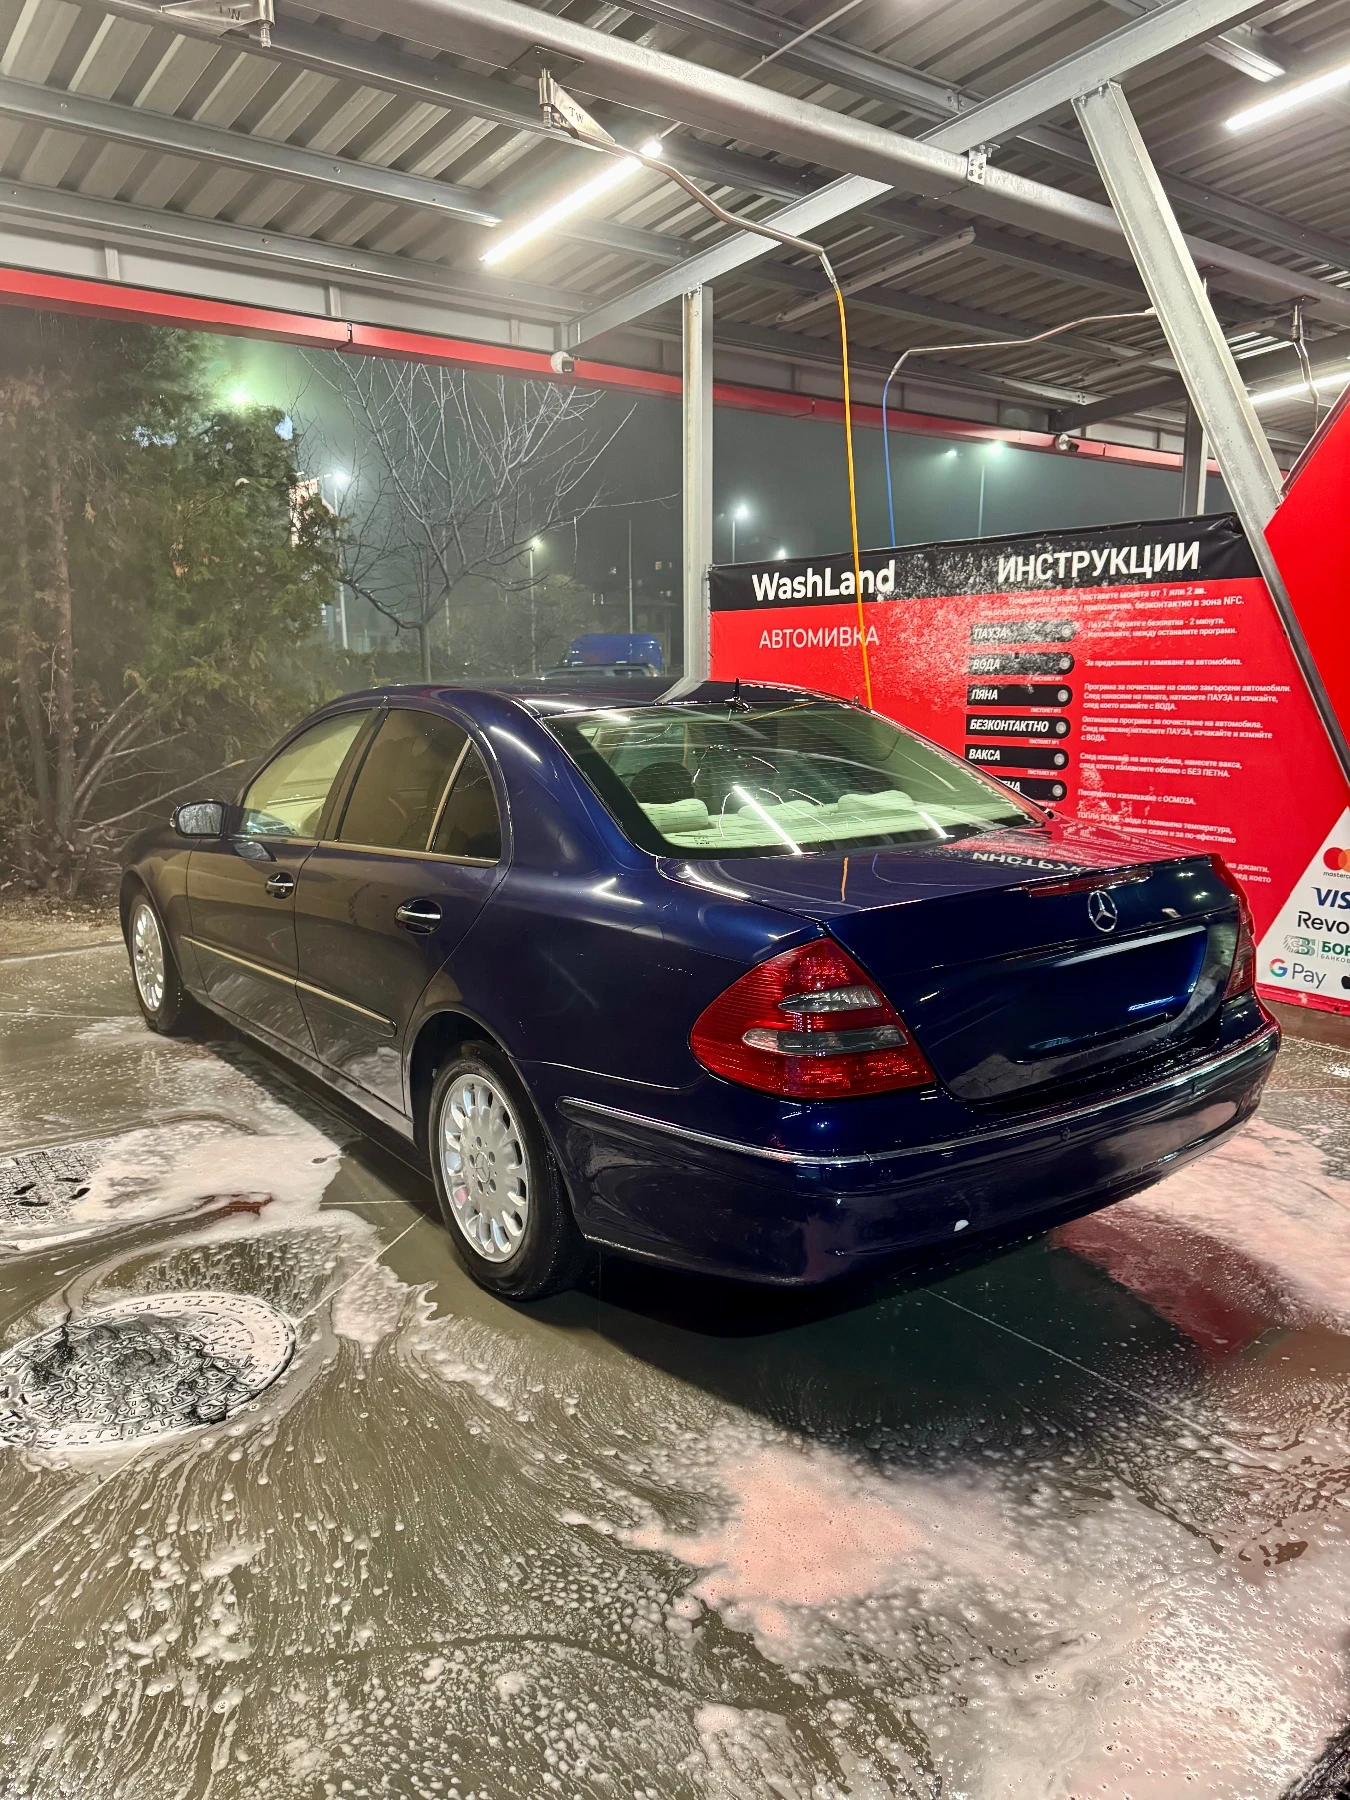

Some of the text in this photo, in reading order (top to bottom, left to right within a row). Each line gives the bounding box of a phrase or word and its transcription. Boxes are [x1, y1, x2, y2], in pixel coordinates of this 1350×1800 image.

[997, 540, 1200, 583] ИНСТРУКЦИИ
[751, 559, 895, 601] WashLand
[1120, 590, 1149, 600] монета
[1151, 589, 1160, 597] от
[1163, 587, 1167, 596] 1
[1169, 588, 1185, 596] или
[1187, 586, 1193, 595] 2
[1135, 599, 1191, 610] безконтактно
[1201, 598, 1221, 606] зона
[1223, 595, 1244, 605] NFC.
[1147, 618, 1184, 627] безплатна
[1190, 617, 1195, 625] 2
[1196, 616, 1225, 626] минути.
[758, 625, 880, 649] АВТОМИВКА
[973, 626, 1007, 640] ПАУЗА
[1133, 629, 1157, 638] между
[1157, 628, 1198, 637] останалите
[1199, 627, 1238, 637] програми.
[972, 658, 1001, 671] ВОДА
[1195, 657, 1243, 666] автомобила.
[971, 688, 999, 700] ПЯНА
[1084, 683, 1117, 691] Програма
[1199, 684, 1241, 692] замърсени
[1242, 683, 1292, 692] автомобили.
[1083, 692, 1101, 701] След
[1207, 694, 1233, 703] ПАУЗА
[1155, 703, 1178, 711] ВОДА.
[969, 719, 1050, 733] БЕЗКОНТАКТНО
[1082, 715, 1119, 724] Оптимална
[1119, 717, 1152, 726] програма
[1162, 719, 1204, 727] почистване
[1214, 720, 1263, 729] автомобила.
[1081, 725, 1099, 733] След
[1130, 727, 1165, 735] натиснете
[1166, 728, 1193, 737] ПАУЗА,
[1239, 730, 1273, 739] измийте
[1086, 734, 1107, 742] ВОДА.
[968, 748, 1001, 761] ВАКСА
[1079, 752, 1097, 761] След
[1140, 756, 1184, 766] автомобила,
[1184, 759, 1218, 767] нанесете
[1218, 761, 1242, 769] вакса,
[1155, 766, 1181, 775] обилно
[1187, 768, 1201, 776] БЕЗ
[1202, 768, 1231, 778] ПЕТНА.
[1163, 794, 1196, 805] ОСМОЗА.
[1147, 819, 1183, 828] повишена
[1183, 822, 1233, 834] температура,
[1149, 828, 1169, 836] сезон
[1185, 832, 1237, 844] по-ефективно
[1237, 863, 1270, 873] джанти.
[1248, 874, 1272, 884] което
[1322, 871, 1350, 880] masterc
[1310, 886, 1350, 910] VIS
[1291, 962, 1327, 989] Pay
